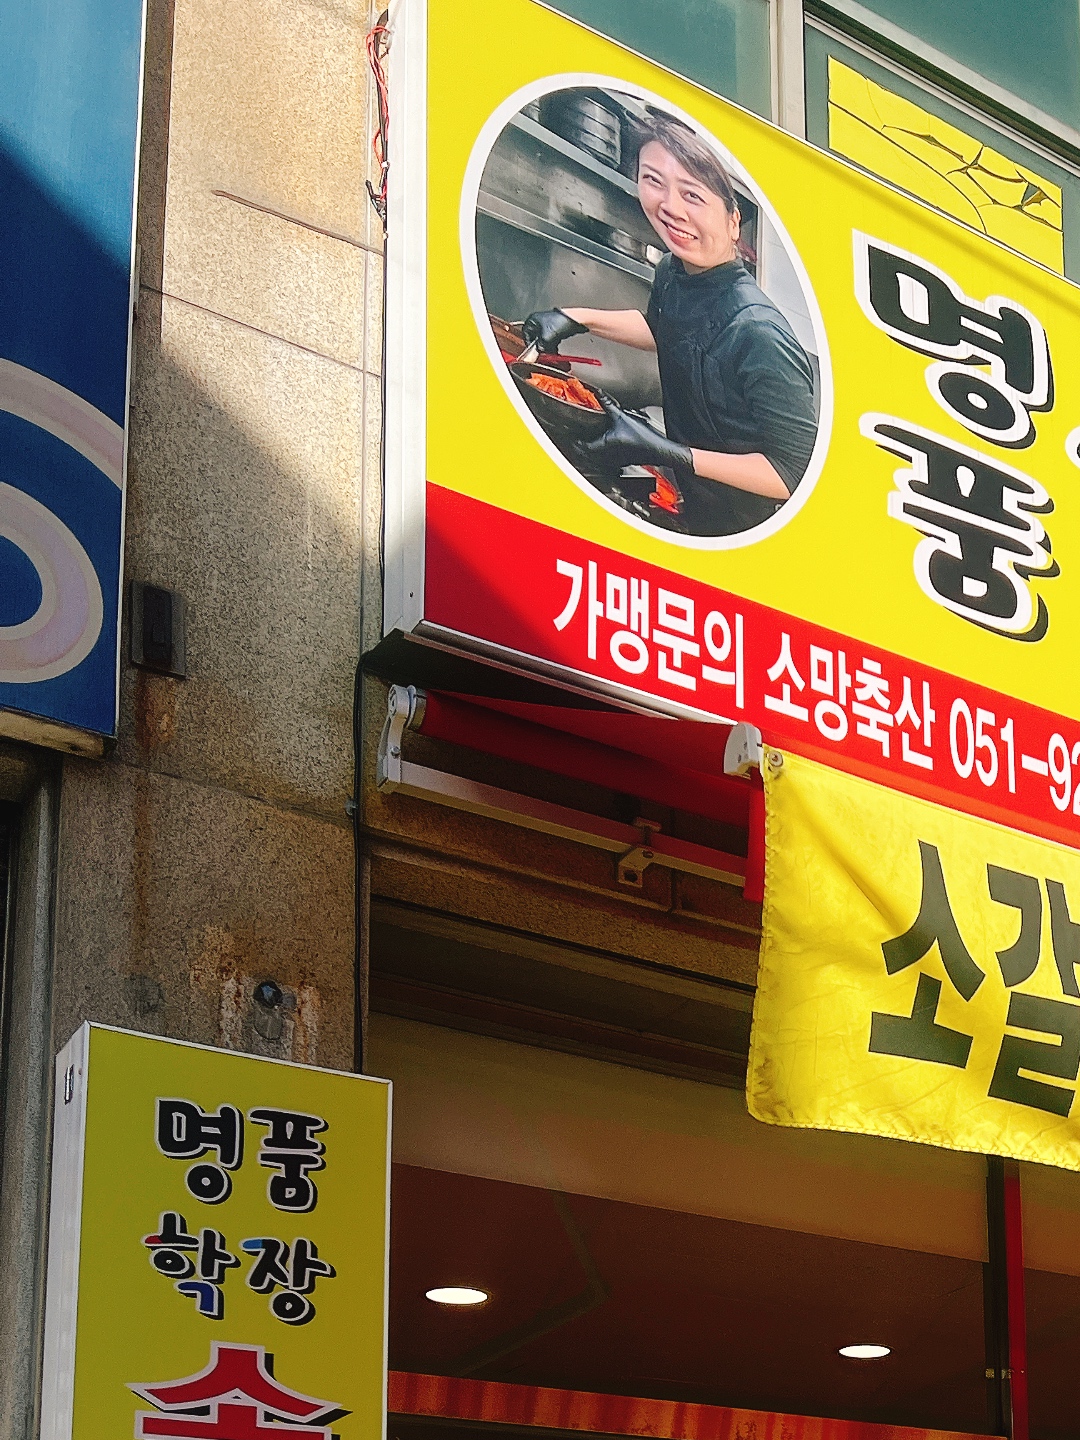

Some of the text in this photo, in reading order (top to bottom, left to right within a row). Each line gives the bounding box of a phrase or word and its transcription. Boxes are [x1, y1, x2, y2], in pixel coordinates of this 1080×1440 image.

[554, 558, 744, 708] 가맹문의
[764, 633, 935, 770] 소망축산
[153, 1096, 329, 1212] 명품
[143, 1211, 337, 1326] 학장
